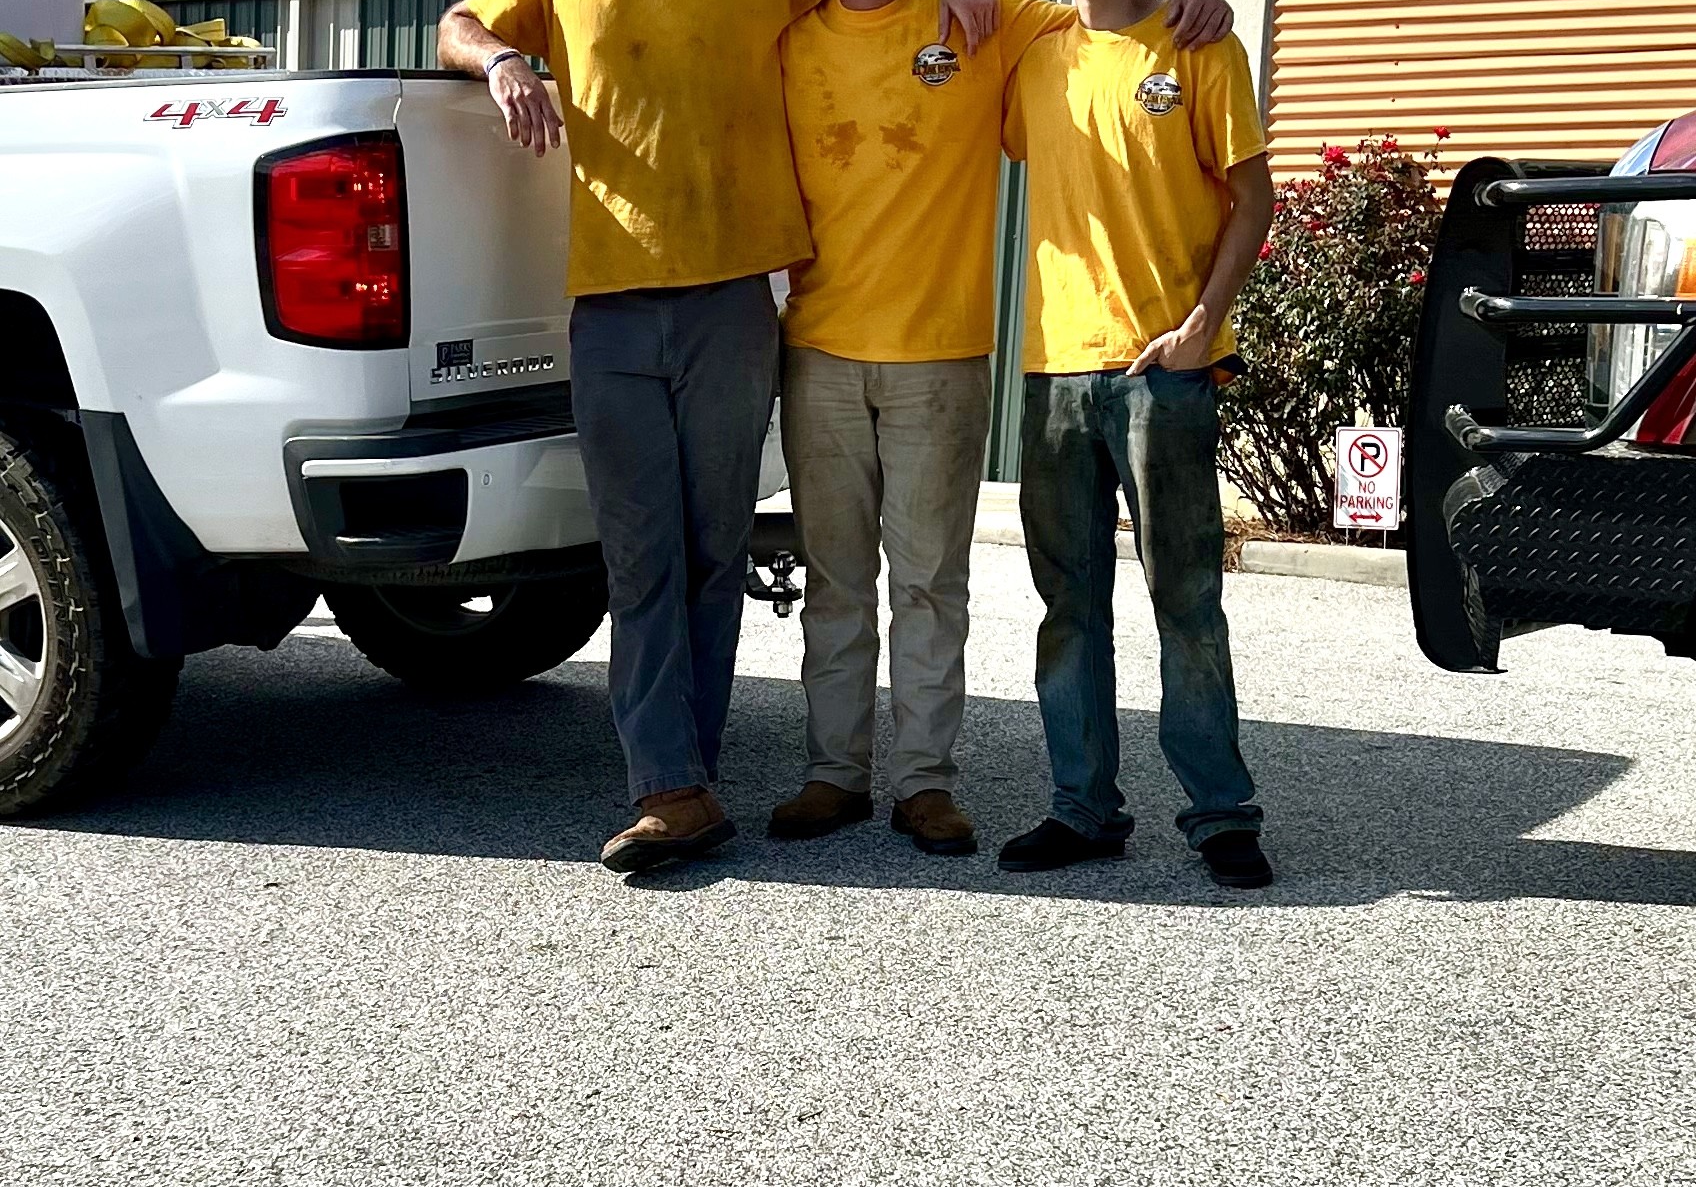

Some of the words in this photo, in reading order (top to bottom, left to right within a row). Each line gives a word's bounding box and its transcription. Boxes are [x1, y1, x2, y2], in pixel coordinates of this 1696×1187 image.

[430, 354, 554, 385] SILVERADO
[1358, 480, 1376, 494] NO
[1338, 494, 1394, 510] PARKING
